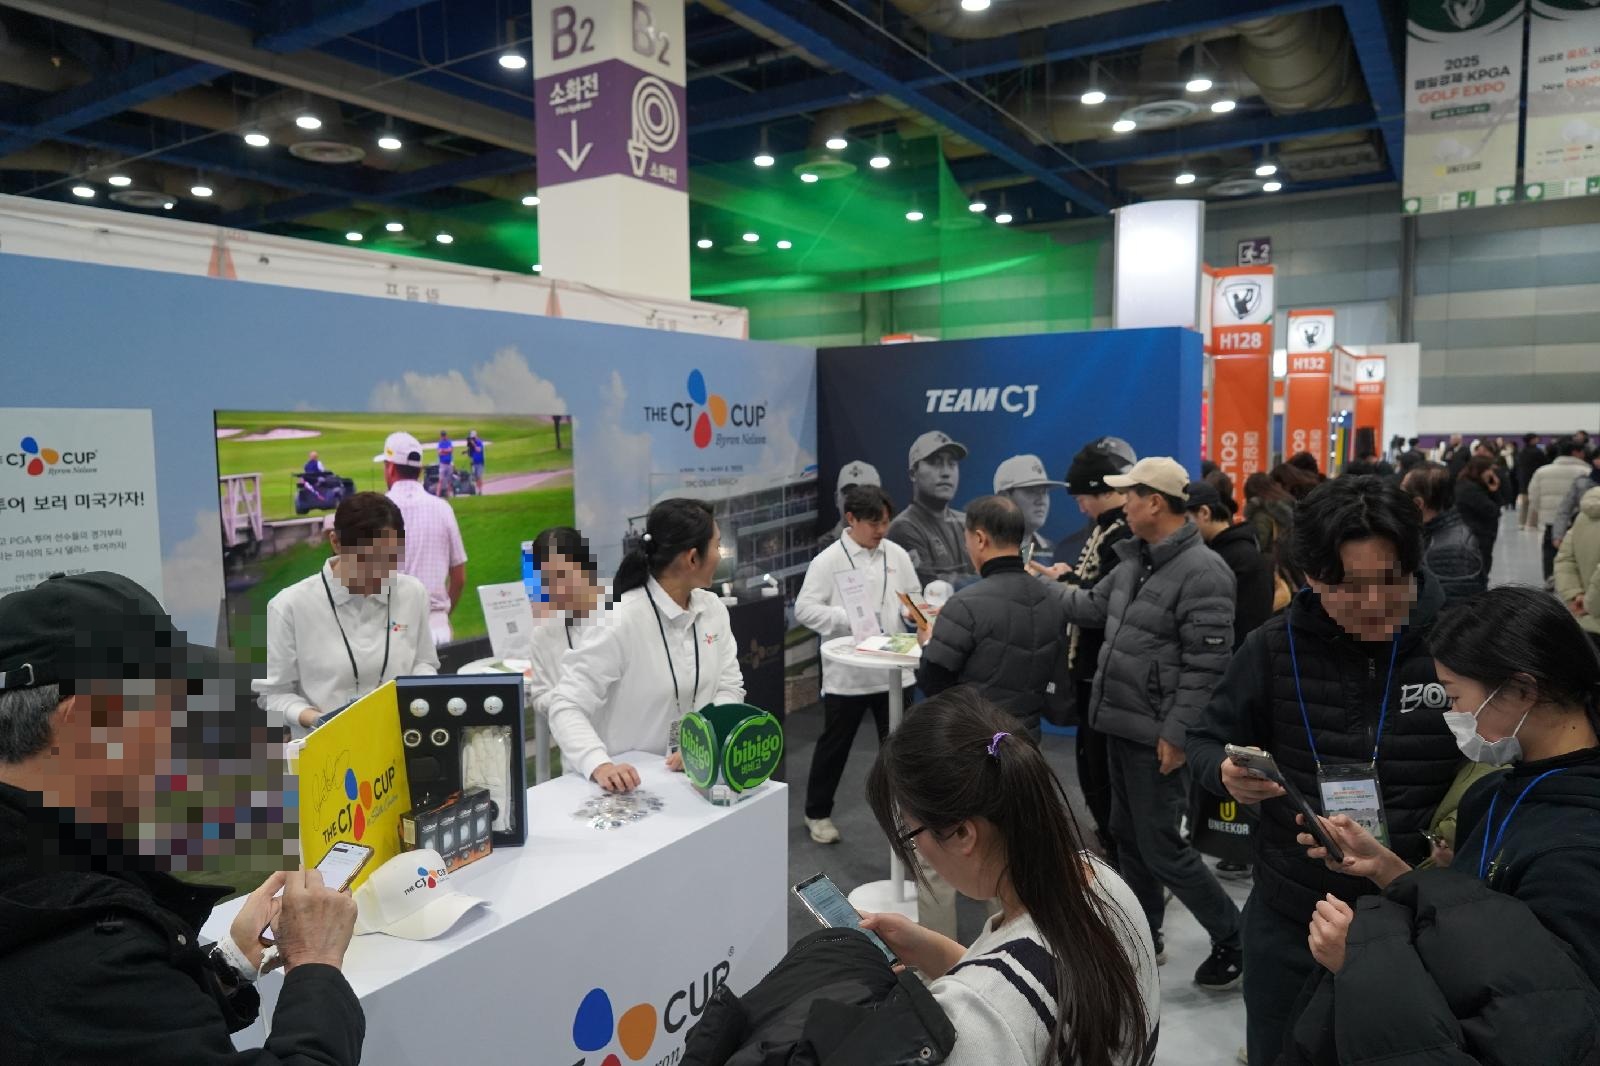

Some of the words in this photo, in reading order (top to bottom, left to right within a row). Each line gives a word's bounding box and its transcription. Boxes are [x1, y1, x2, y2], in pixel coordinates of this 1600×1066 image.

[552, 5, 596, 61] B2
[632, 1, 671, 66] B2
[1445, 55, 1480, 71] 2025
[1467, 65, 1511, 81] KPGA
[549, 72, 599, 105] 소화전
[1418, 86, 1460, 104] GOLF
[1463, 80, 1506, 97] EXPO
[1220, 333, 1263, 350] H128
[1293, 357, 1325, 371] H132
[926, 387, 1000, 413] TEAM
[1000, 384, 1039, 418] CJ
[644, 406, 668, 422] THE
[670, 402, 694, 432] CJ
[731, 403, 766, 427] CUP
[6, 453, 26, 468] CJ
[62, 451, 96, 465] CUP
[33, 495, 68, 511] 보러
[75, 491, 144, 510] 미국가자!
[10, 535, 32, 545] PGA
[682, 728, 710, 770] bibigo
[733, 735, 780, 768] bibigo
[322, 821, 337, 845] THE
[338, 803, 352, 834] CJ
[374, 766, 395, 800] CUP
[415, 877, 426, 888] CJ
[663, 959, 731, 1034] CUP
